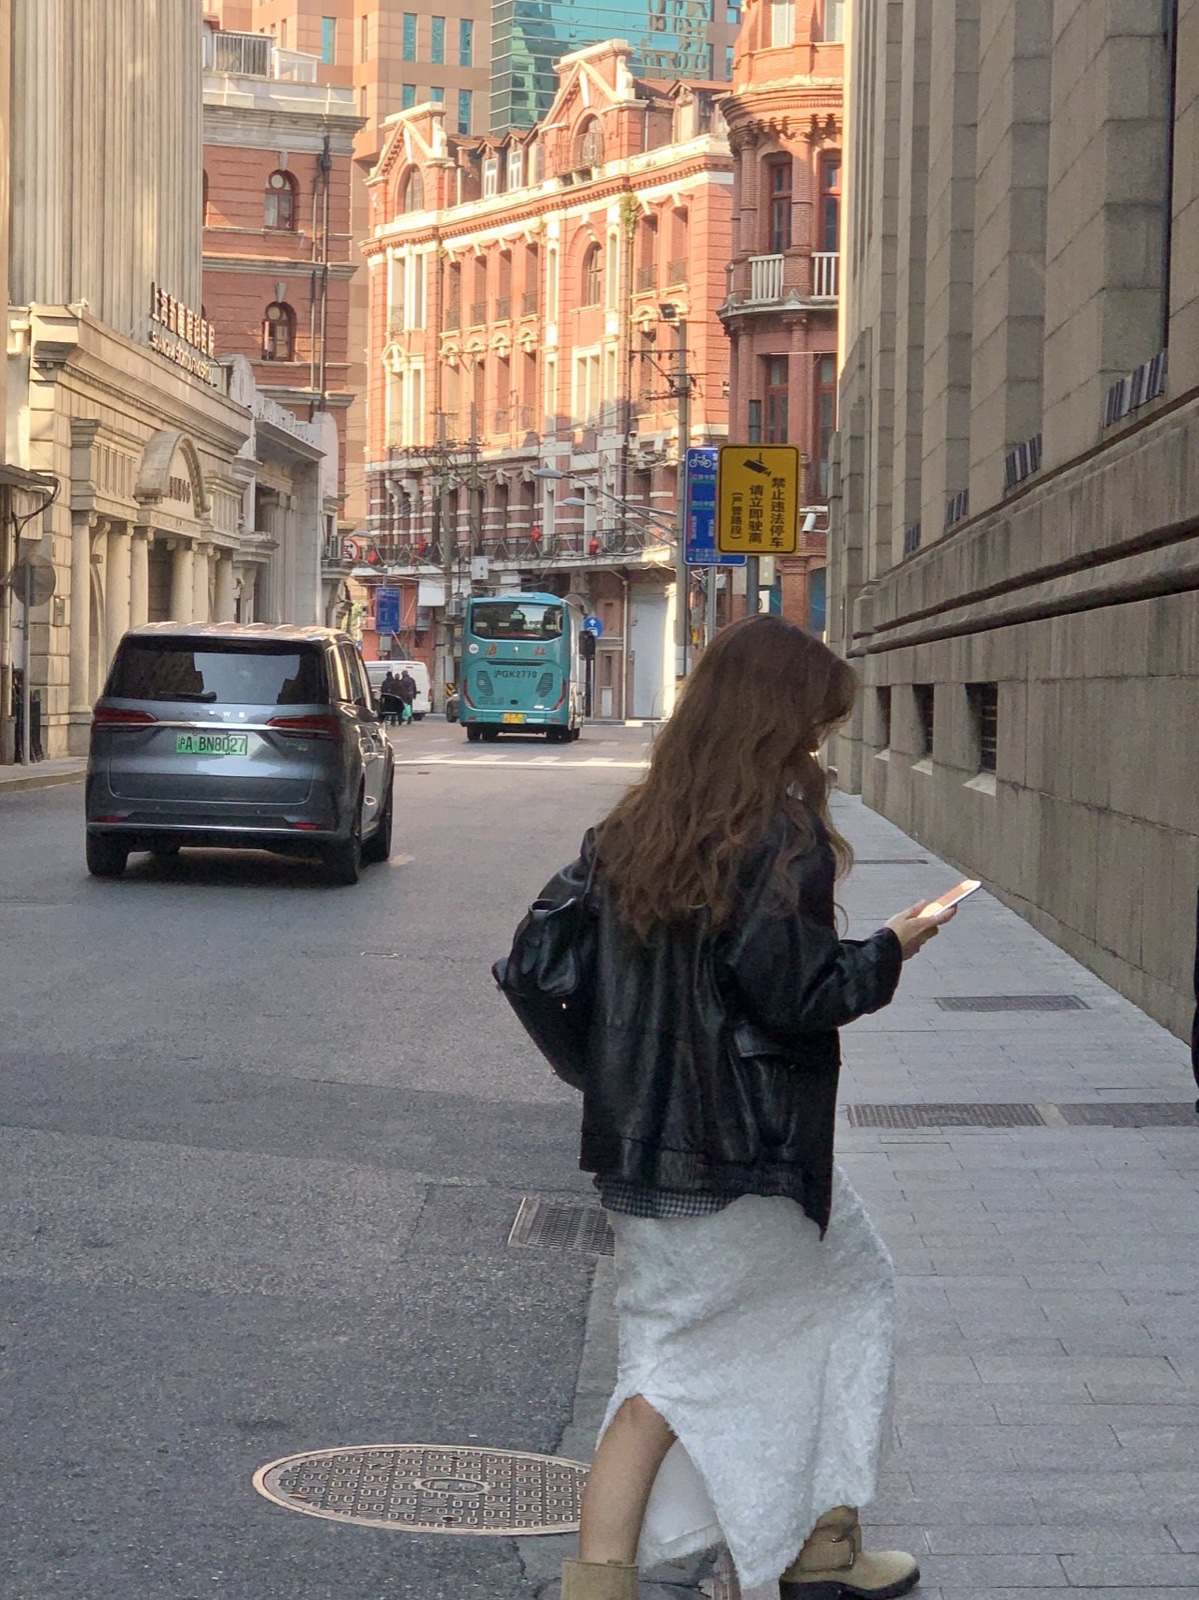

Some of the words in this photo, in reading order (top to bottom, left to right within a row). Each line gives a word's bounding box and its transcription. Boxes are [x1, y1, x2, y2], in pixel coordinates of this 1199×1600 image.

[748, 484, 764, 544] 请立即驶离
[769, 477, 786, 548] 禁止违法停车
[198, 736, 246, 753] BN8027
